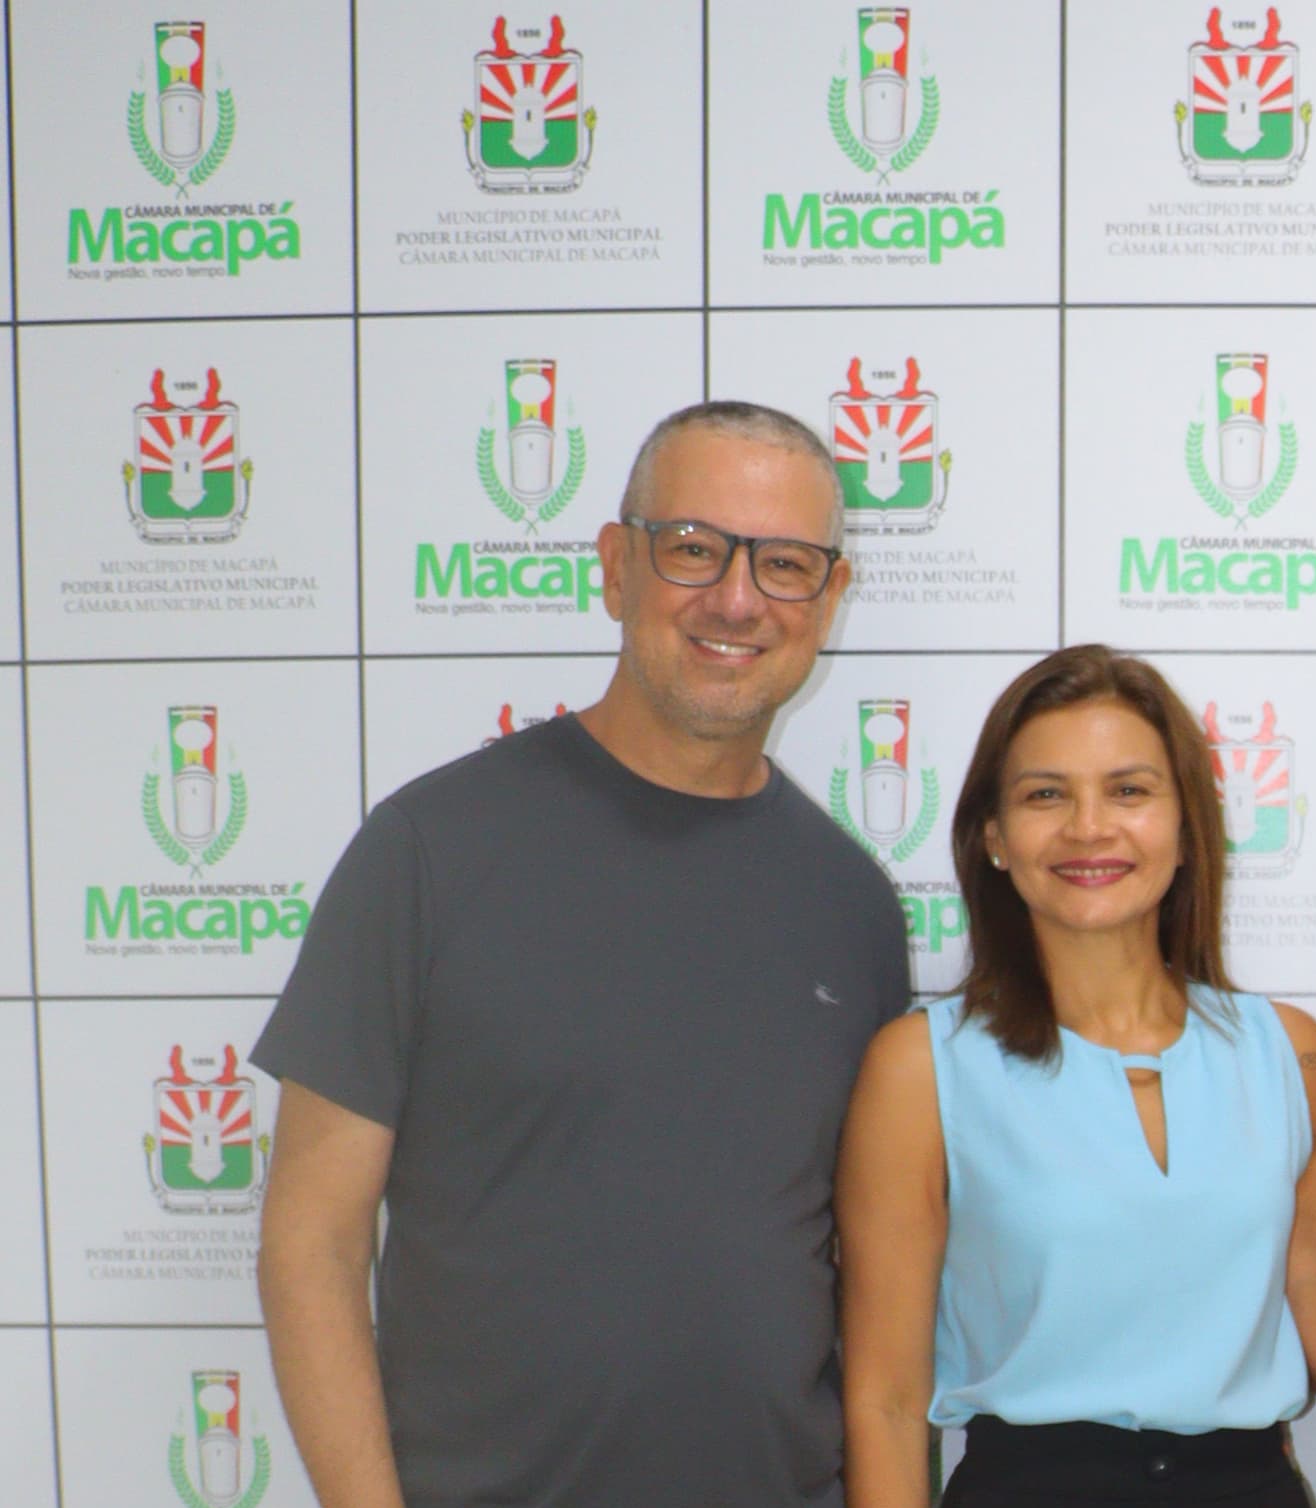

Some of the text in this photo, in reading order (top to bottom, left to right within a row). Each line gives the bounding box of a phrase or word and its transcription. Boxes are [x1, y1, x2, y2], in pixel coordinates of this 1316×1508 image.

[823, 190, 980, 204] CÂMARA MUNICIPAL DE
[125, 203, 276, 218] CÂMARA MUNICIPAL DE
[437, 207, 621, 224] MUNICÍPIO DE MACAPÁ
[1148, 200, 1240, 216] MUNICÍPIO
[1242, 202, 1264, 216] DE
[763, 189, 1005, 265] Macapá
[1105, 223, 1160, 237] PODER
[1167, 222, 1278, 236] LEGISLATIVO
[68, 201, 300, 276] Macapá
[396, 227, 663, 245] PODER LEGISLATIVO MUNICIPAL
[400, 245, 660, 265] CÂMARA MUNICIPAL DE MACAPÁ
[1108, 239, 1180, 256] CÂMARA
[1184, 241, 1276, 256] MUNICIPAL
[1283, 241, 1305, 256] DE
[763, 254, 796, 265] Nova
[851, 255, 882, 264] novo
[887, 254, 926, 266] tempo
[68, 268, 99, 279] Nova
[152, 267, 184, 278] novo
[186, 266, 224, 278] tempo
[473, 539, 530, 554] CÂMARA
[1180, 536, 1238, 550] CÂMARA
[1244, 538, 1316, 549] MUNICIPAL
[189, 559, 207, 573] DE
[415, 543, 603, 612] Macap
[922, 570, 1018, 583] MUNICIPAL
[61, 576, 319, 594] PODER LEGISLATIVO MUNICIPAL
[135, 598, 222, 611] MUNICIPAL
[227, 597, 247, 610] DE
[416, 603, 448, 614] Nova
[502, 602, 532, 613] novo
[536, 602, 575, 614] tempo
[1120, 599, 1153, 610] Nova
[1209, 599, 1239, 610] novo
[1244, 599, 1284, 611] tempo
[141, 883, 288, 897] CÂMARA MUNICIPAL DE
[85, 882, 311, 955] Macapá
